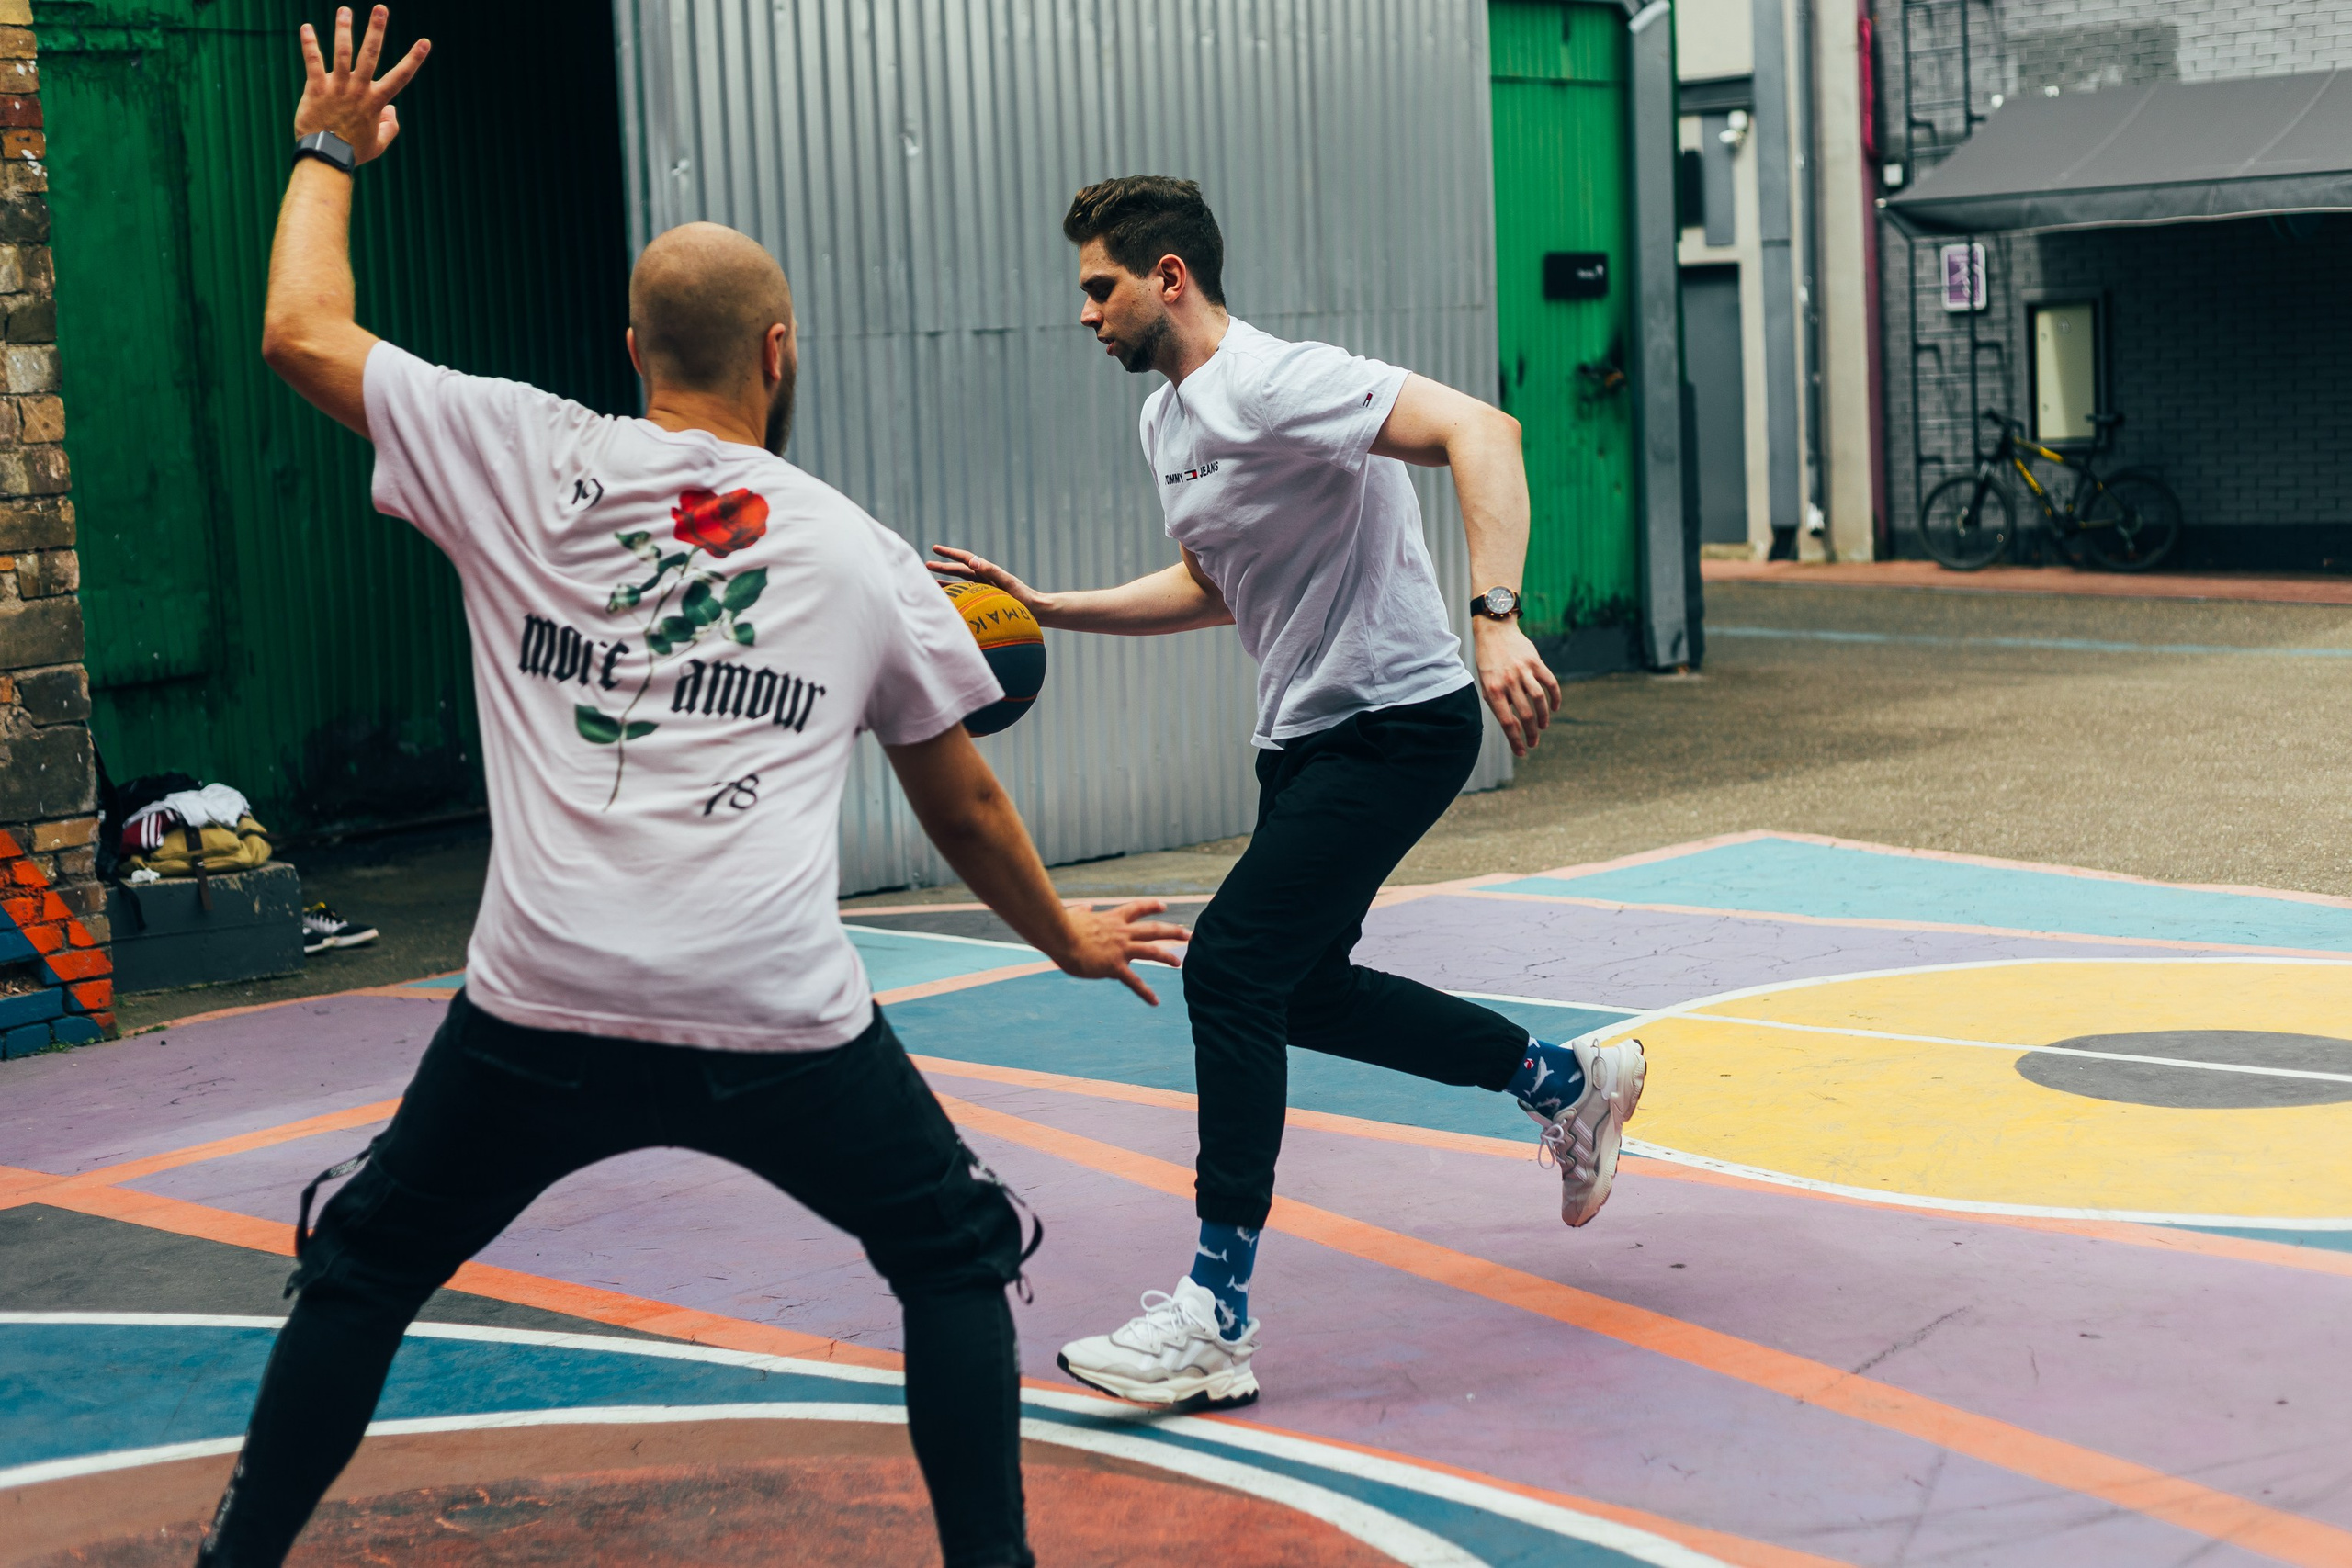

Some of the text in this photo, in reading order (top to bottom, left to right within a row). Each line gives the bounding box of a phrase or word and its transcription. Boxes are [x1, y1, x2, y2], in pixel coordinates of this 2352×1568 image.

[1199, 461, 1219, 478] JEANS
[571, 478, 605, 512] 19
[670, 658, 826, 734] amour
[703, 773, 759, 816] 78
